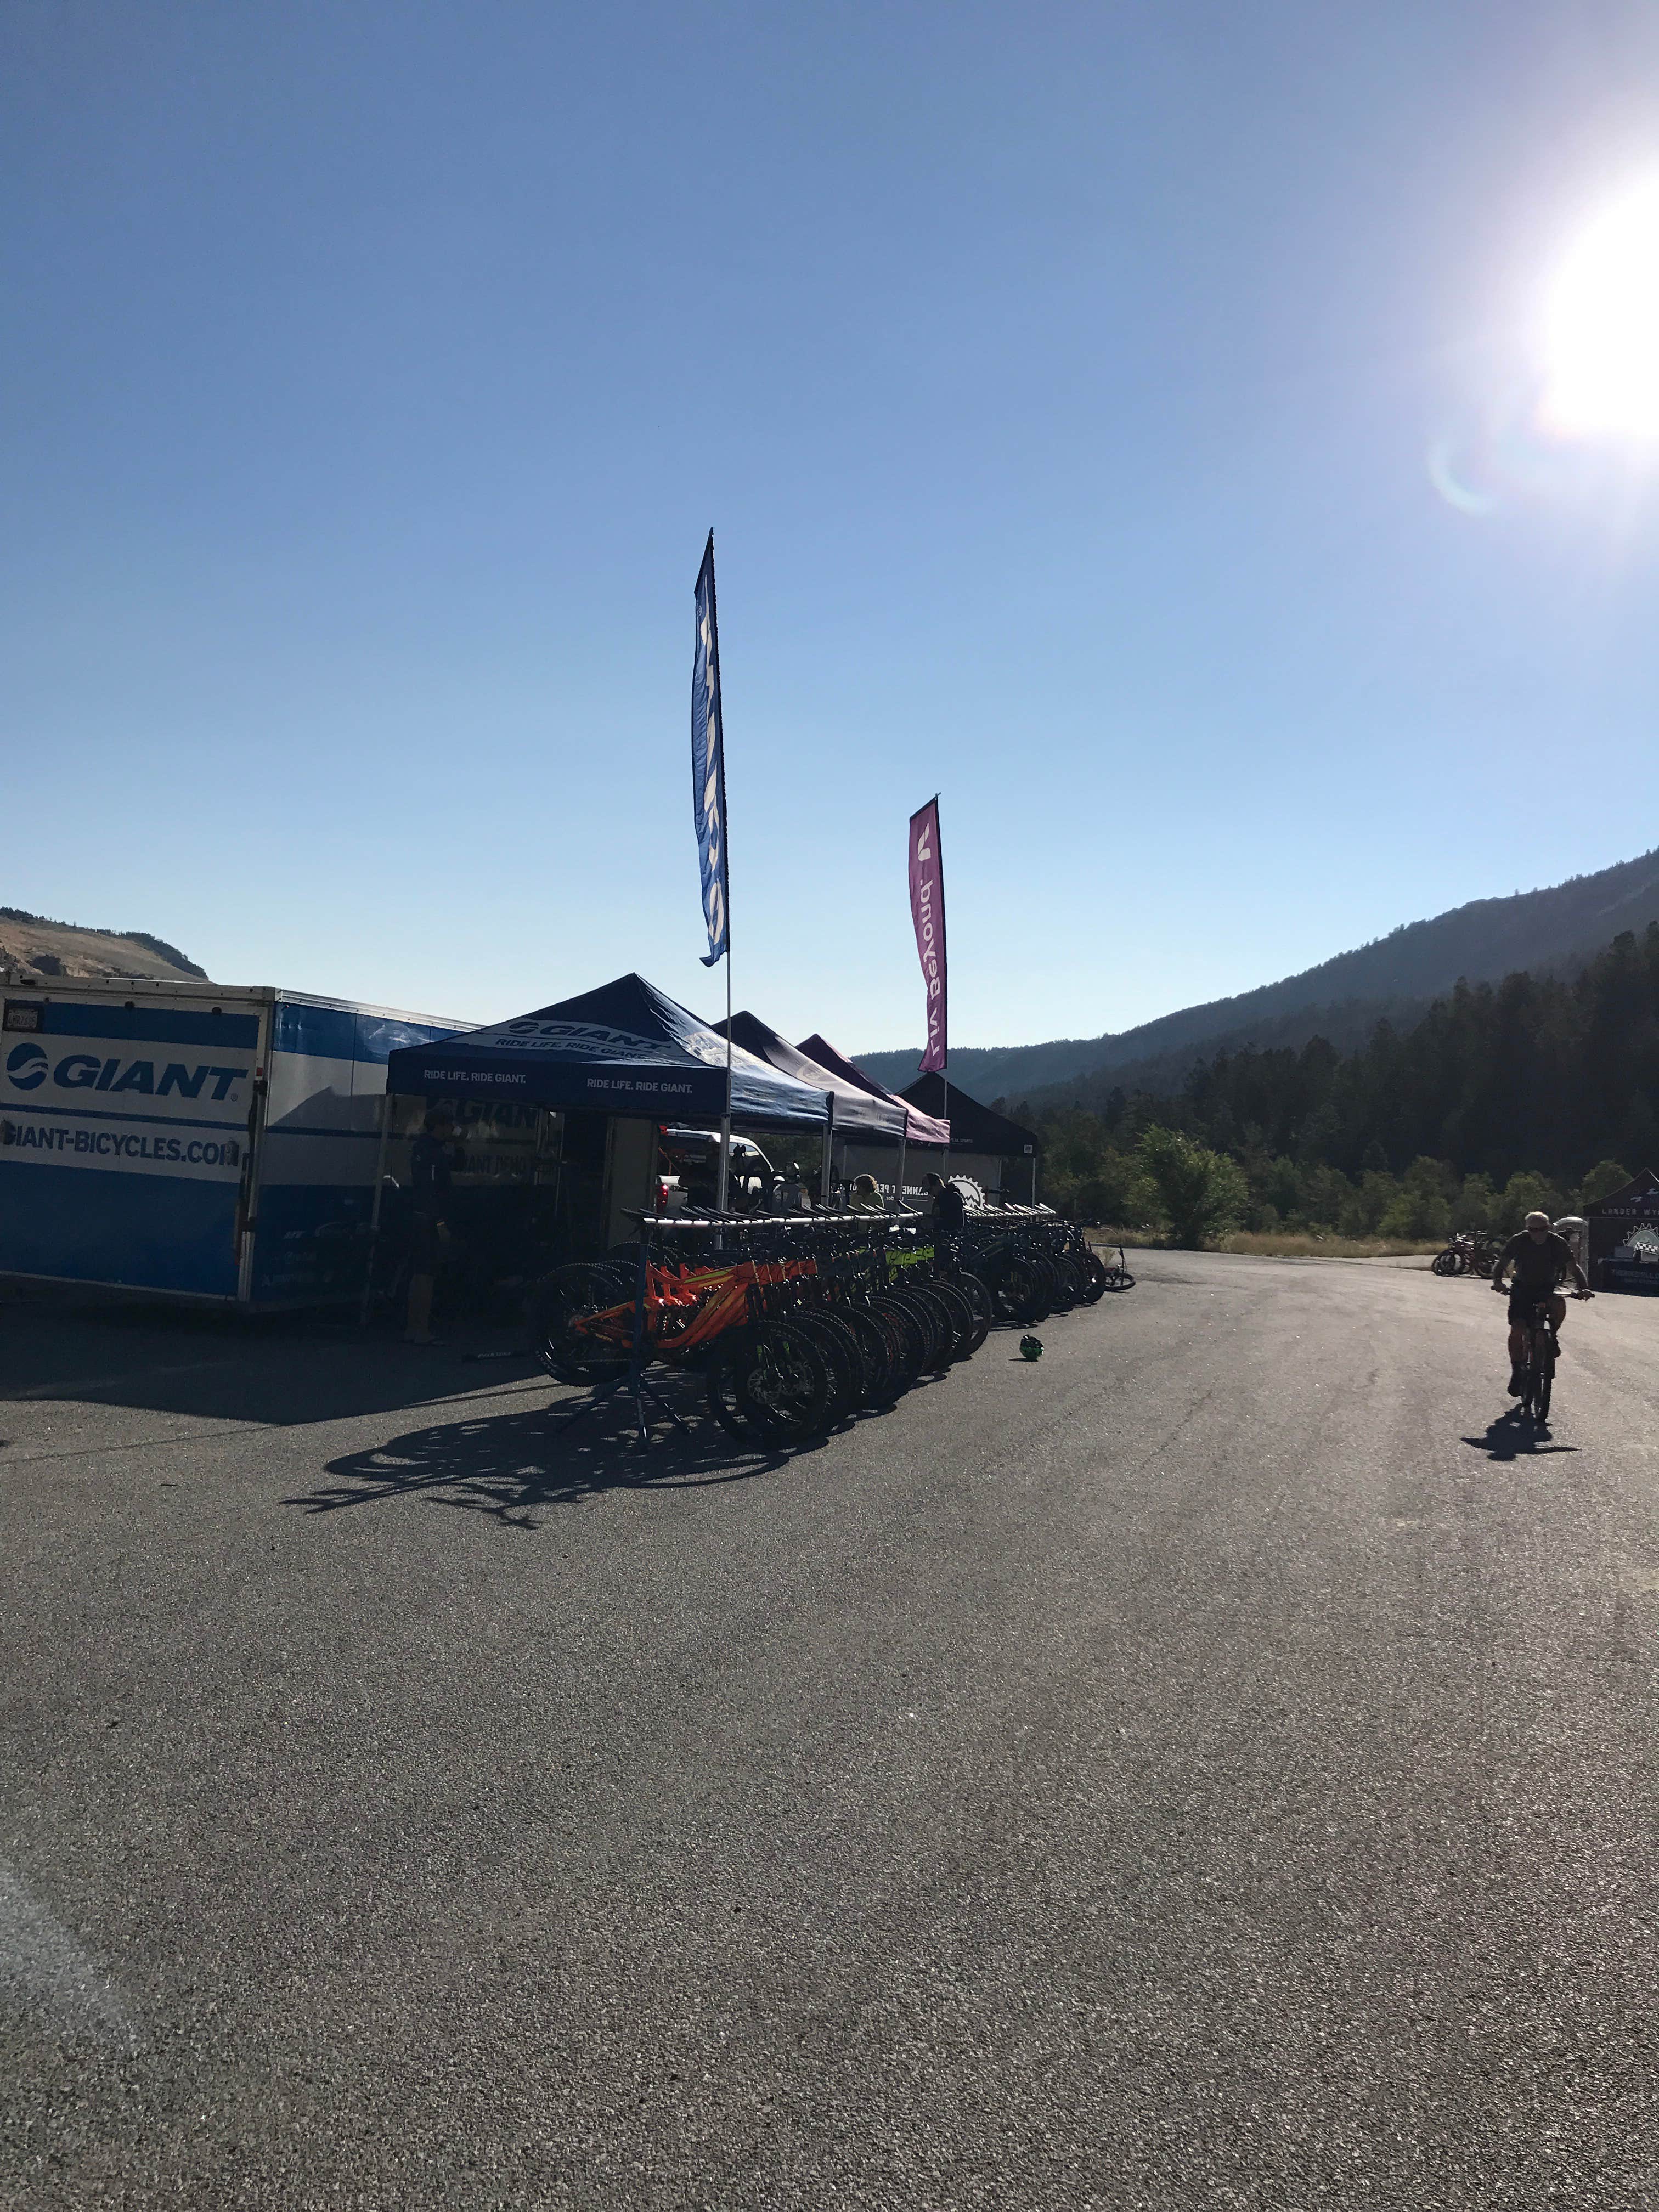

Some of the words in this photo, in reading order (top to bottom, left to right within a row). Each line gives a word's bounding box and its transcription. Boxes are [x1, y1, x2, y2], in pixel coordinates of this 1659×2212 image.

[540, 1025, 671, 1049] GIANT
[496, 1039, 530, 1047] RIDE
[566, 1042, 599, 1052] RIDE
[53, 1054, 249, 1101] GIANT
[424, 1070, 445, 1079] RIDE
[471, 1073, 493, 1082] RIDE
[495, 1074, 526, 1084] GIANT.
[587, 1079, 609, 1088] RIDE
[611, 1080, 633, 1090] LIFE.
[636, 1081, 658, 1091] RIDE
[661, 1083, 692, 1093] GIANT.
